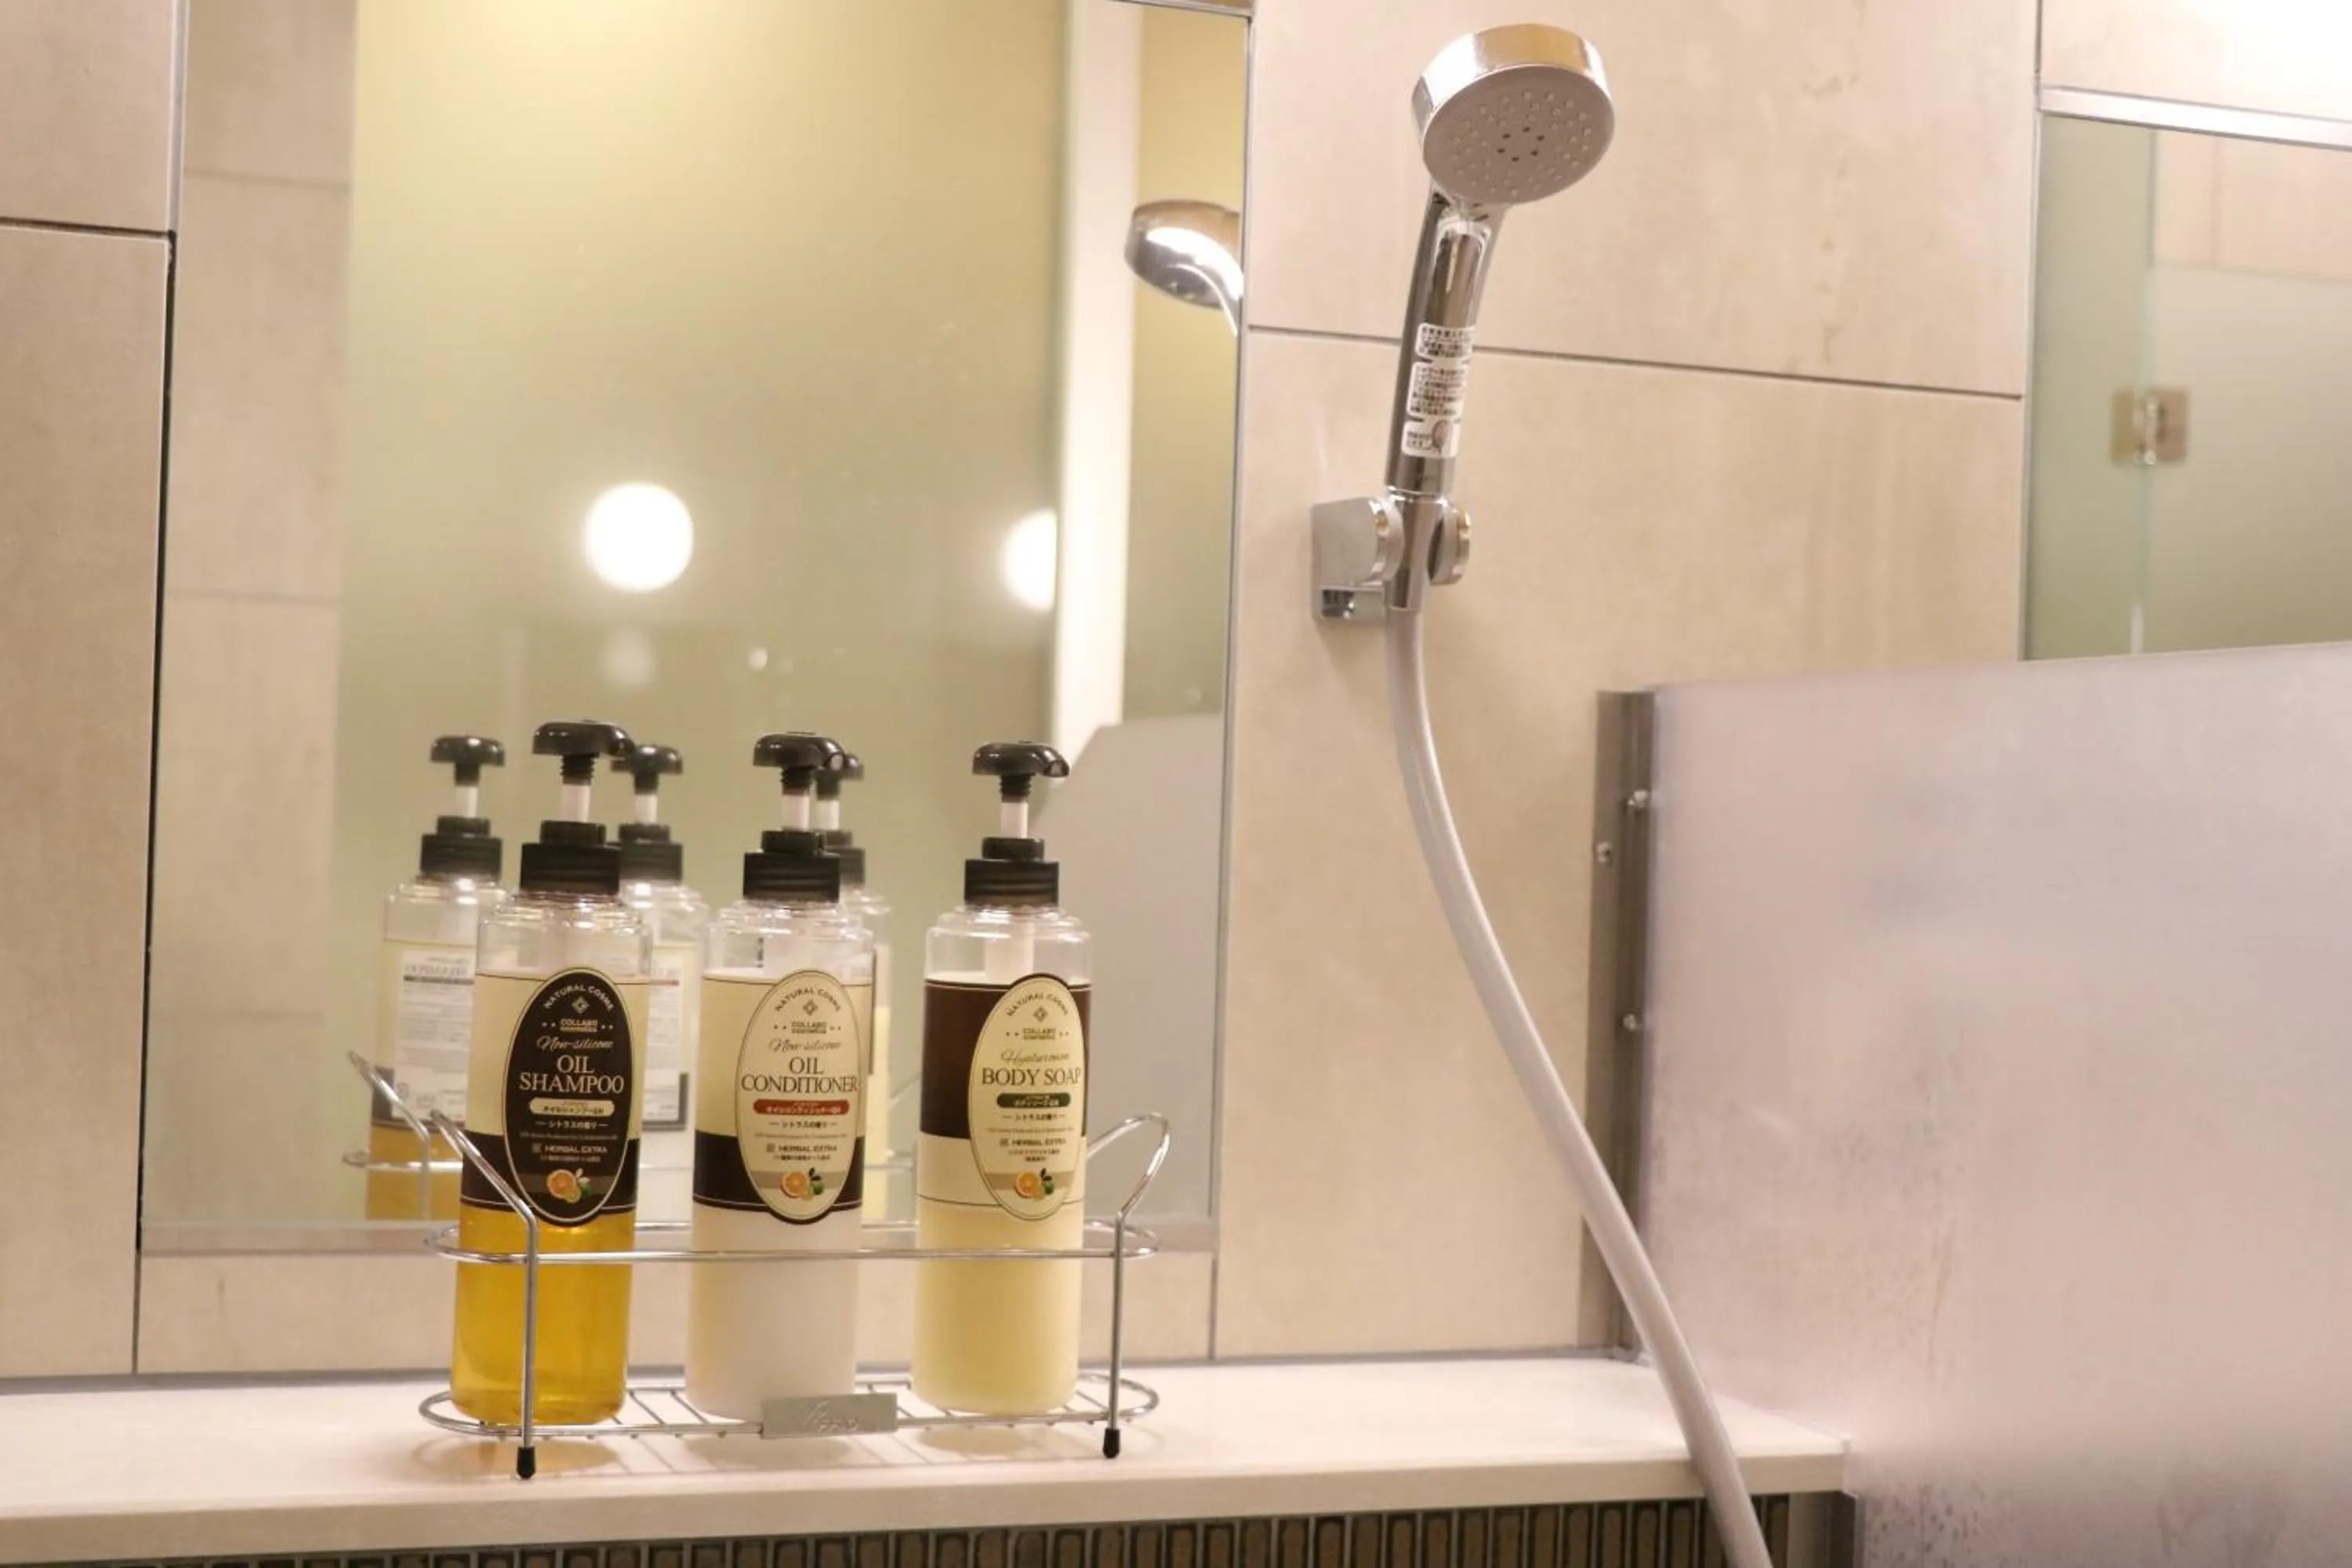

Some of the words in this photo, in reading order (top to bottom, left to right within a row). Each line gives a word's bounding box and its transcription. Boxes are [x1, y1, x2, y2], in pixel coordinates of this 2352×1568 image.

[543, 984, 586, 1010] NATURAL
[775, 987, 814, 1012] NATURAL
[1006, 993, 1044, 1017] NATURAL
[556, 1054, 595, 1074] OIL
[789, 1056, 825, 1075] OIL
[518, 1071, 625, 1094] SHAMPOO
[741, 1073, 858, 1094] CONDITIONER
[982, 1067, 1040, 1087] BODY
[1043, 1066, 1082, 1087] SOAP
